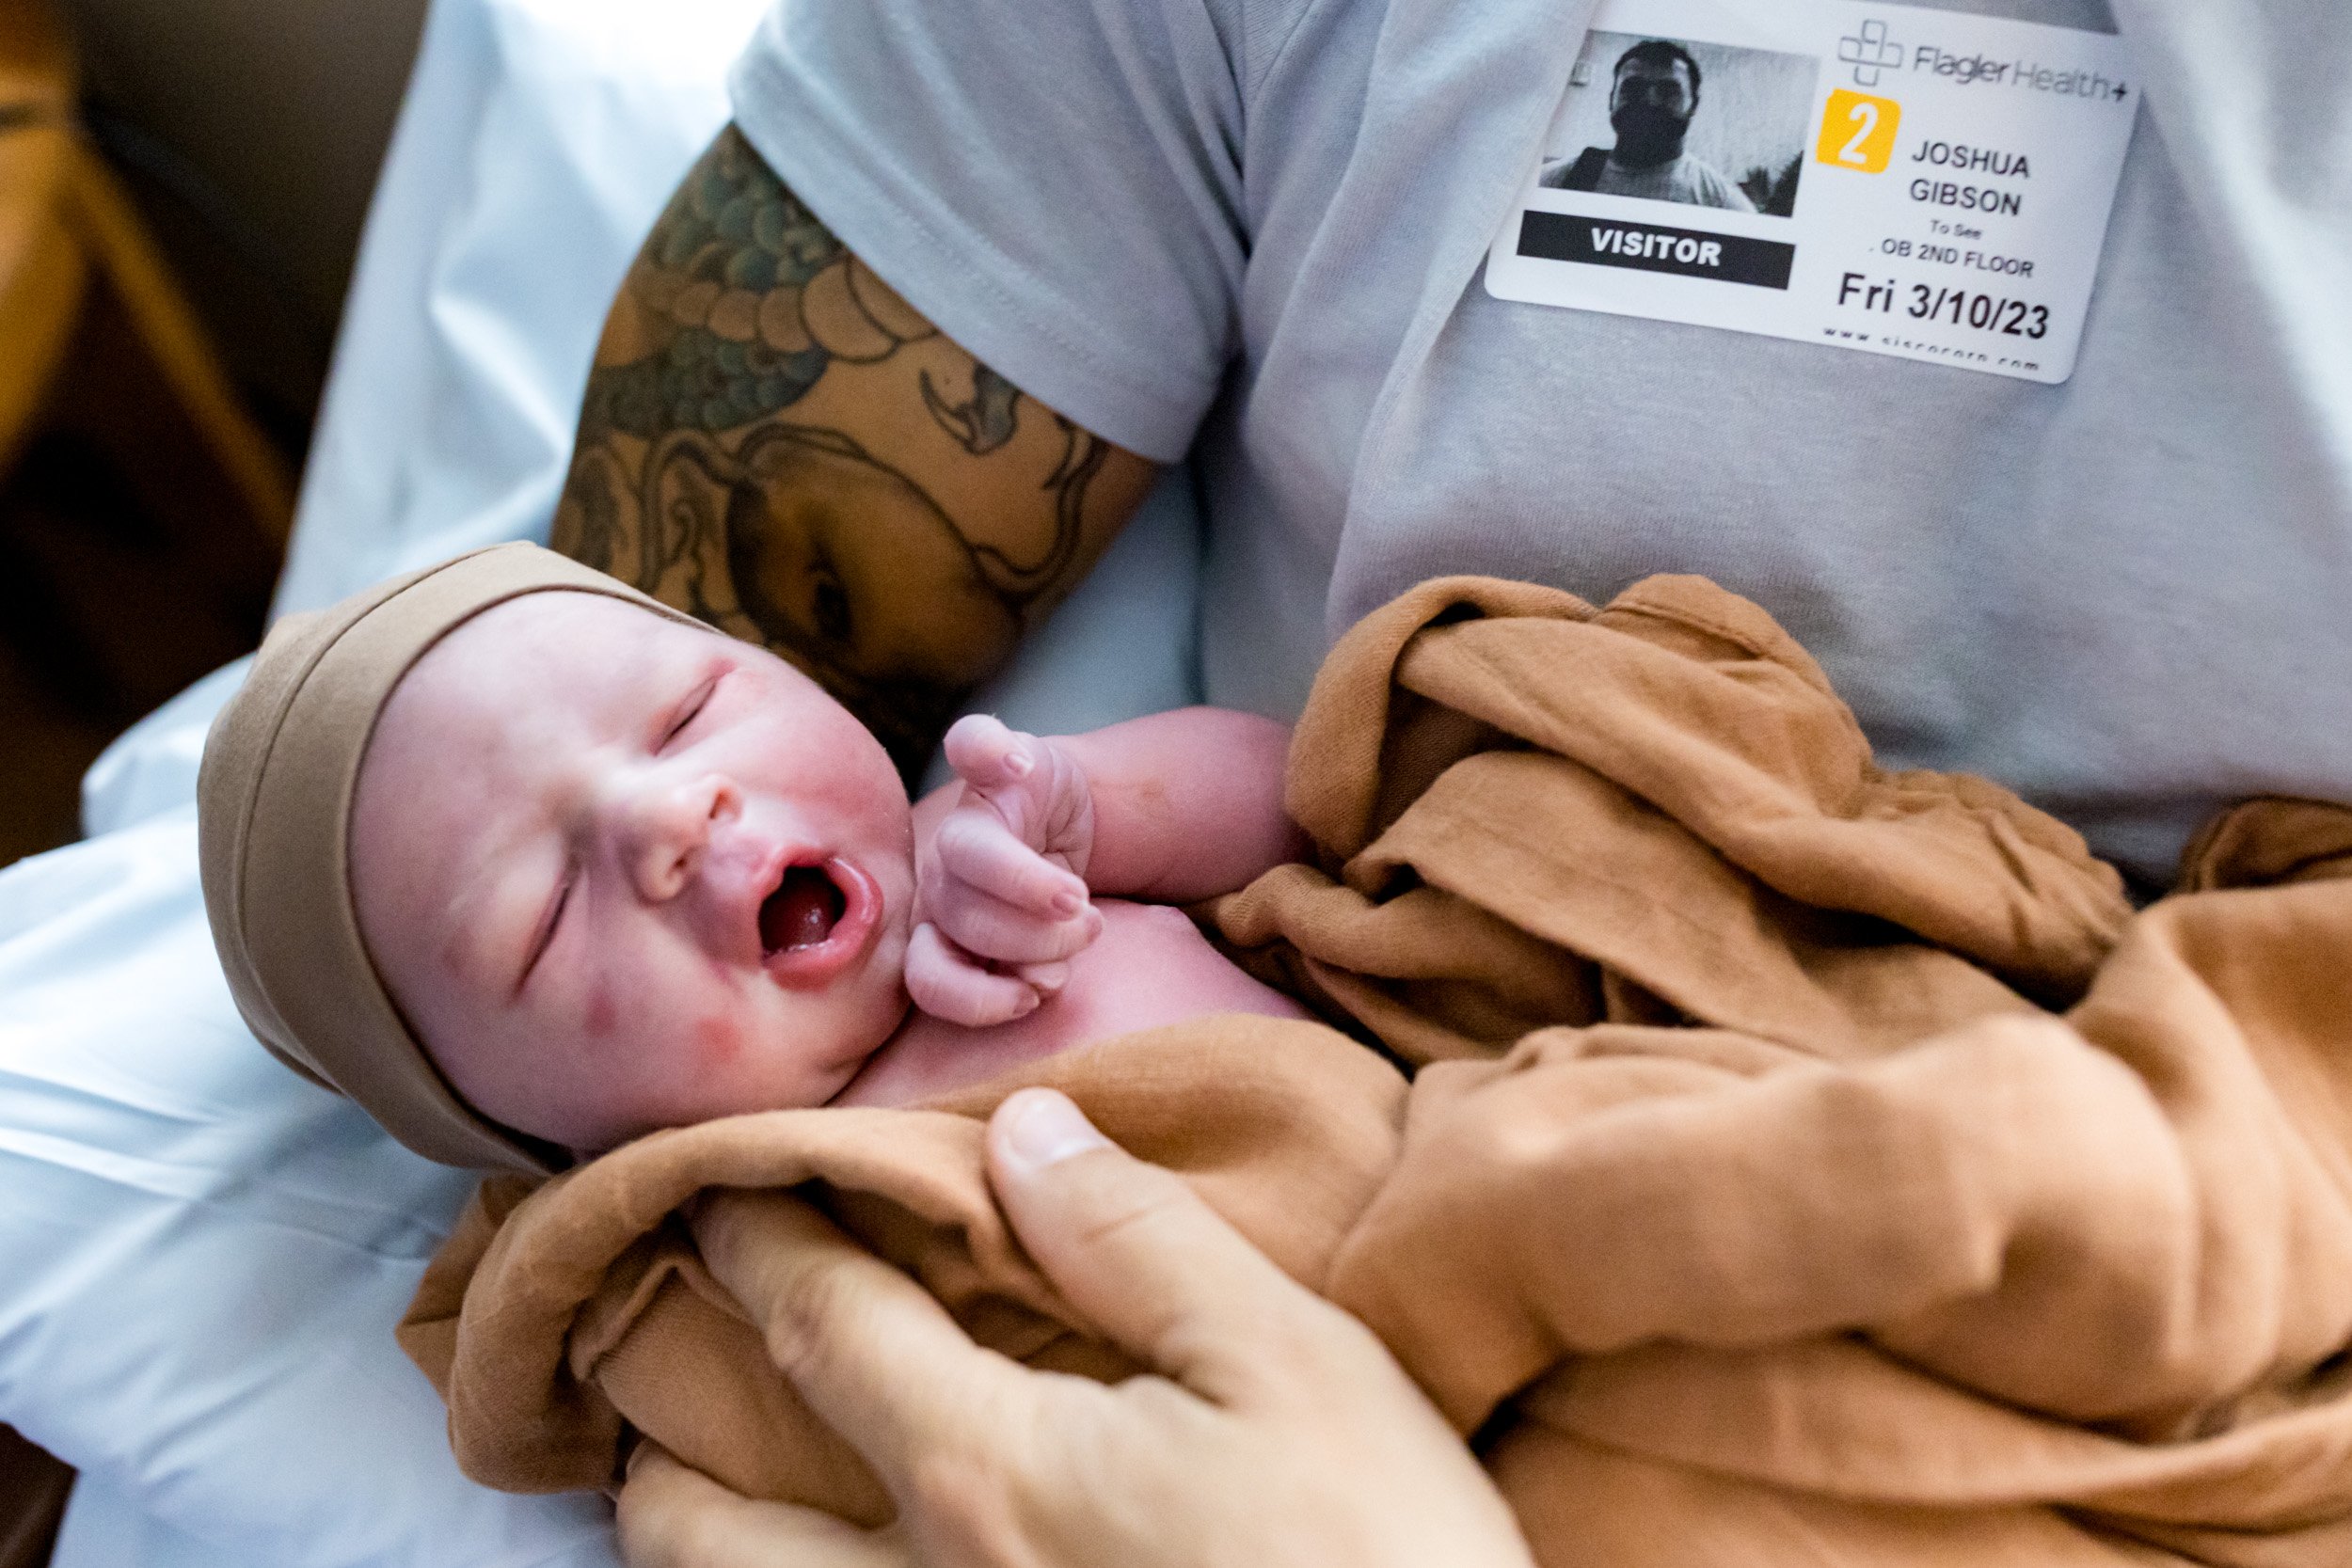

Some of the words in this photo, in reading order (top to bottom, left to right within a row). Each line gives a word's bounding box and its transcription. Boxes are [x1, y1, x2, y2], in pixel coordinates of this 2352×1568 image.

[1838, 103, 1878, 164] 2
[1912, 141, 2030, 178] JOSHUA
[1910, 179, 2022, 216] GIBSON
[1591, 228, 1722, 266] VISITOR
[1931, 219, 1948, 234] To
[1954, 223, 1982, 240] See
[1882, 238, 1912, 257] OB
[1918, 244, 1958, 264] 2ND
[1964, 251, 2034, 277] FLOOR
[1838, 272, 1896, 312] Fri
[1908, 284, 2049, 340] 3/10/23
